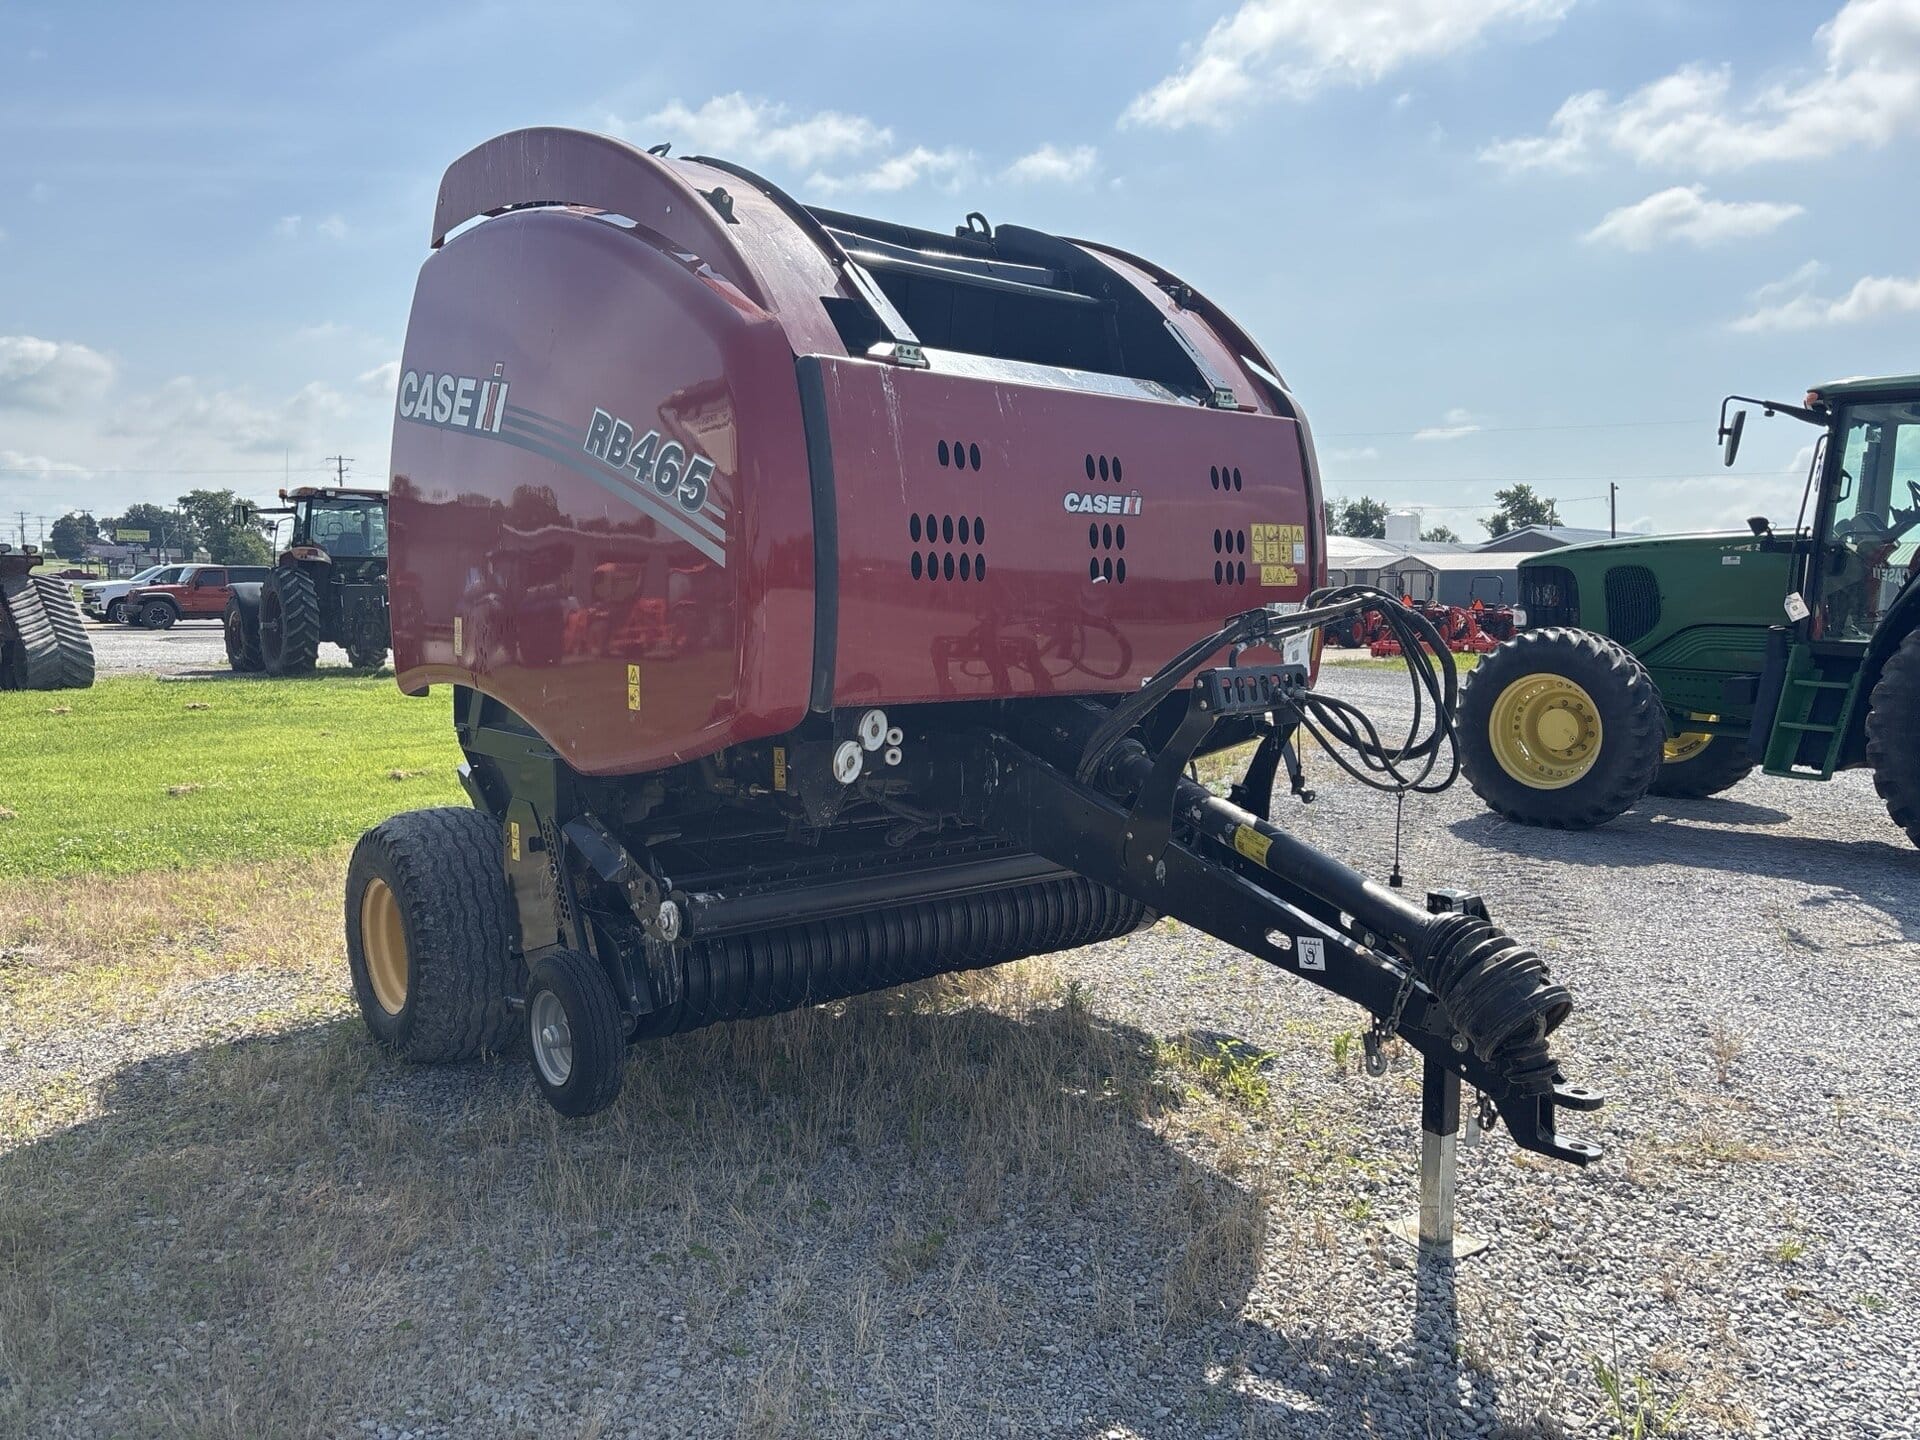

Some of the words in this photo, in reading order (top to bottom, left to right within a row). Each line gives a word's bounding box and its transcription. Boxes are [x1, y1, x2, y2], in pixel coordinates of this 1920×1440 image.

[400, 371, 476, 426] CASE
[583, 407, 716, 514] RB465
[1063, 492, 1122, 513] CASE
